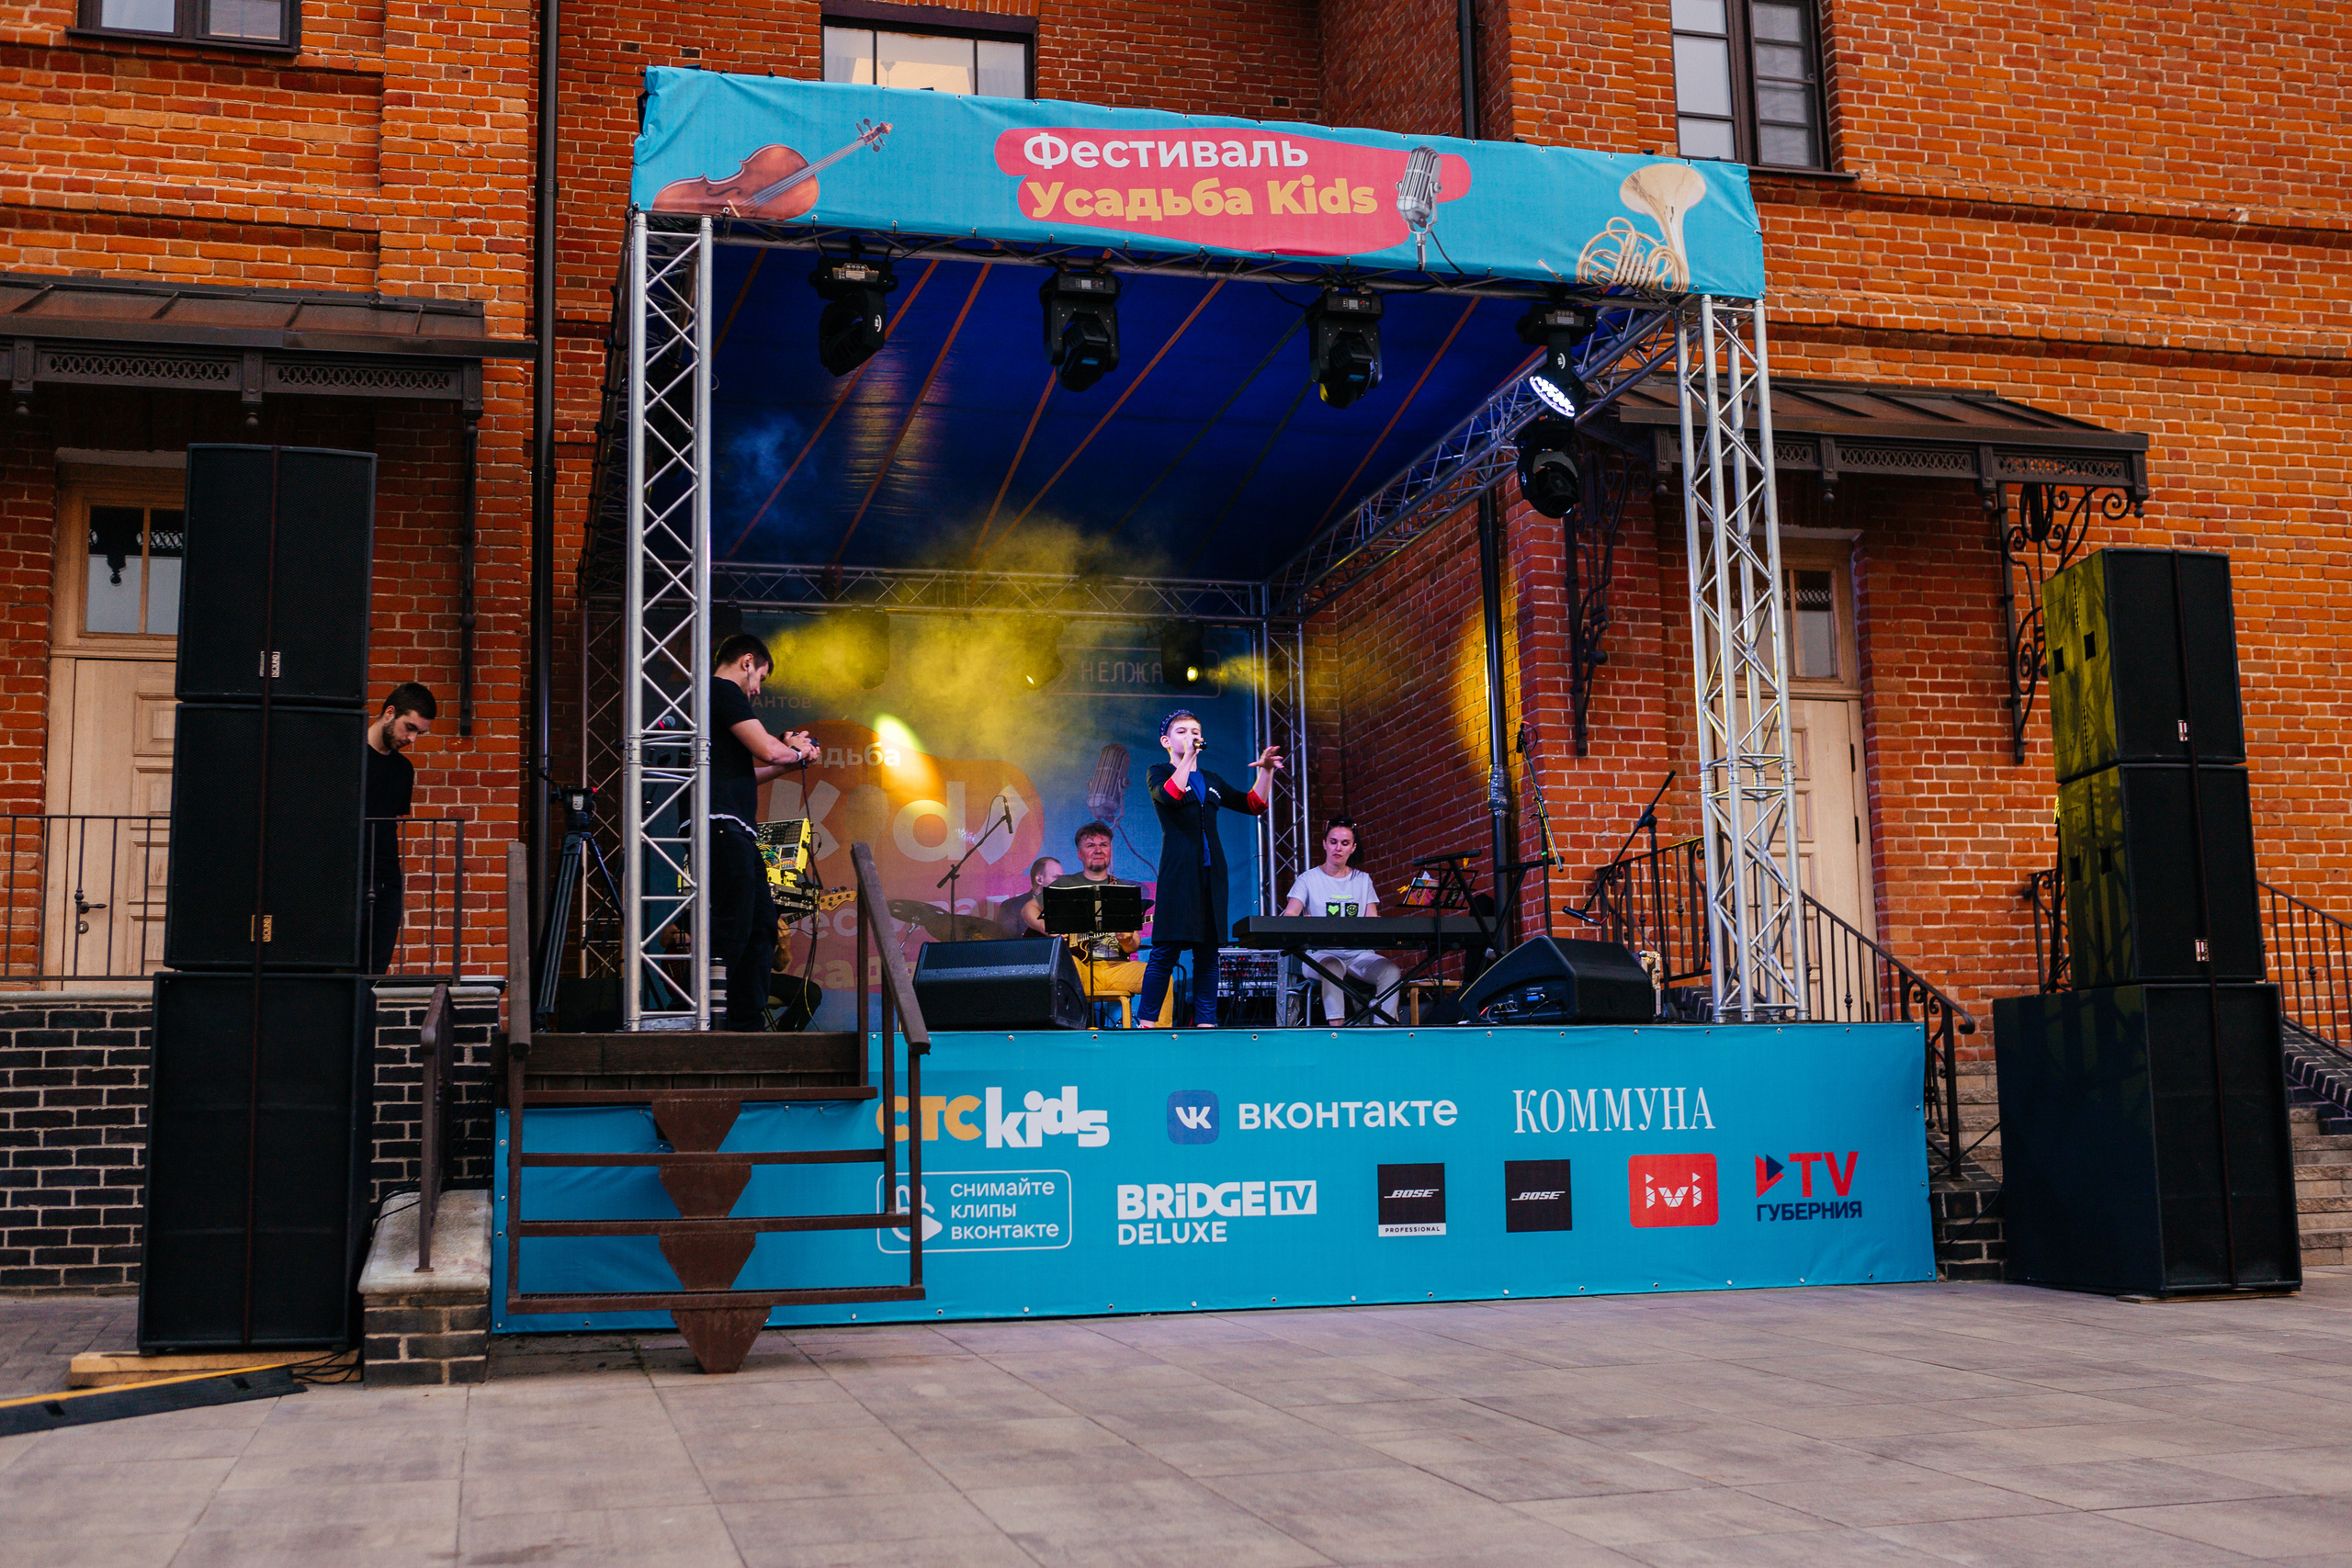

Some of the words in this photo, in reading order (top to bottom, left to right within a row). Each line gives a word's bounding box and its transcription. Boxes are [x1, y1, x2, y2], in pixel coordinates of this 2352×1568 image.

[1023, 131, 1309, 170] Фестиваль
[1025, 177, 1254, 222] Усадьба
[1267, 175, 1378, 215] Kids
[1080, 660, 1163, 683] НЕЛЖА
[1238, 1100, 1458, 1130] вконтакте
[1512, 1087, 1716, 1134] КОММУНА
[1789, 1151, 1860, 1198] TV
[950, 1178, 1056, 1197] снимайте
[1384, 1189, 1440, 1199] BOSE
[1511, 1190, 1566, 1201] BOSE
[1645, 1172, 1702, 1209] ivi
[950, 1203, 1017, 1219] клипы
[1757, 1201, 1863, 1223] ГУБЕРНИЯ
[951, 1224, 1059, 1240] вконтакте
[1117, 1221, 1227, 1246] DELUXE
